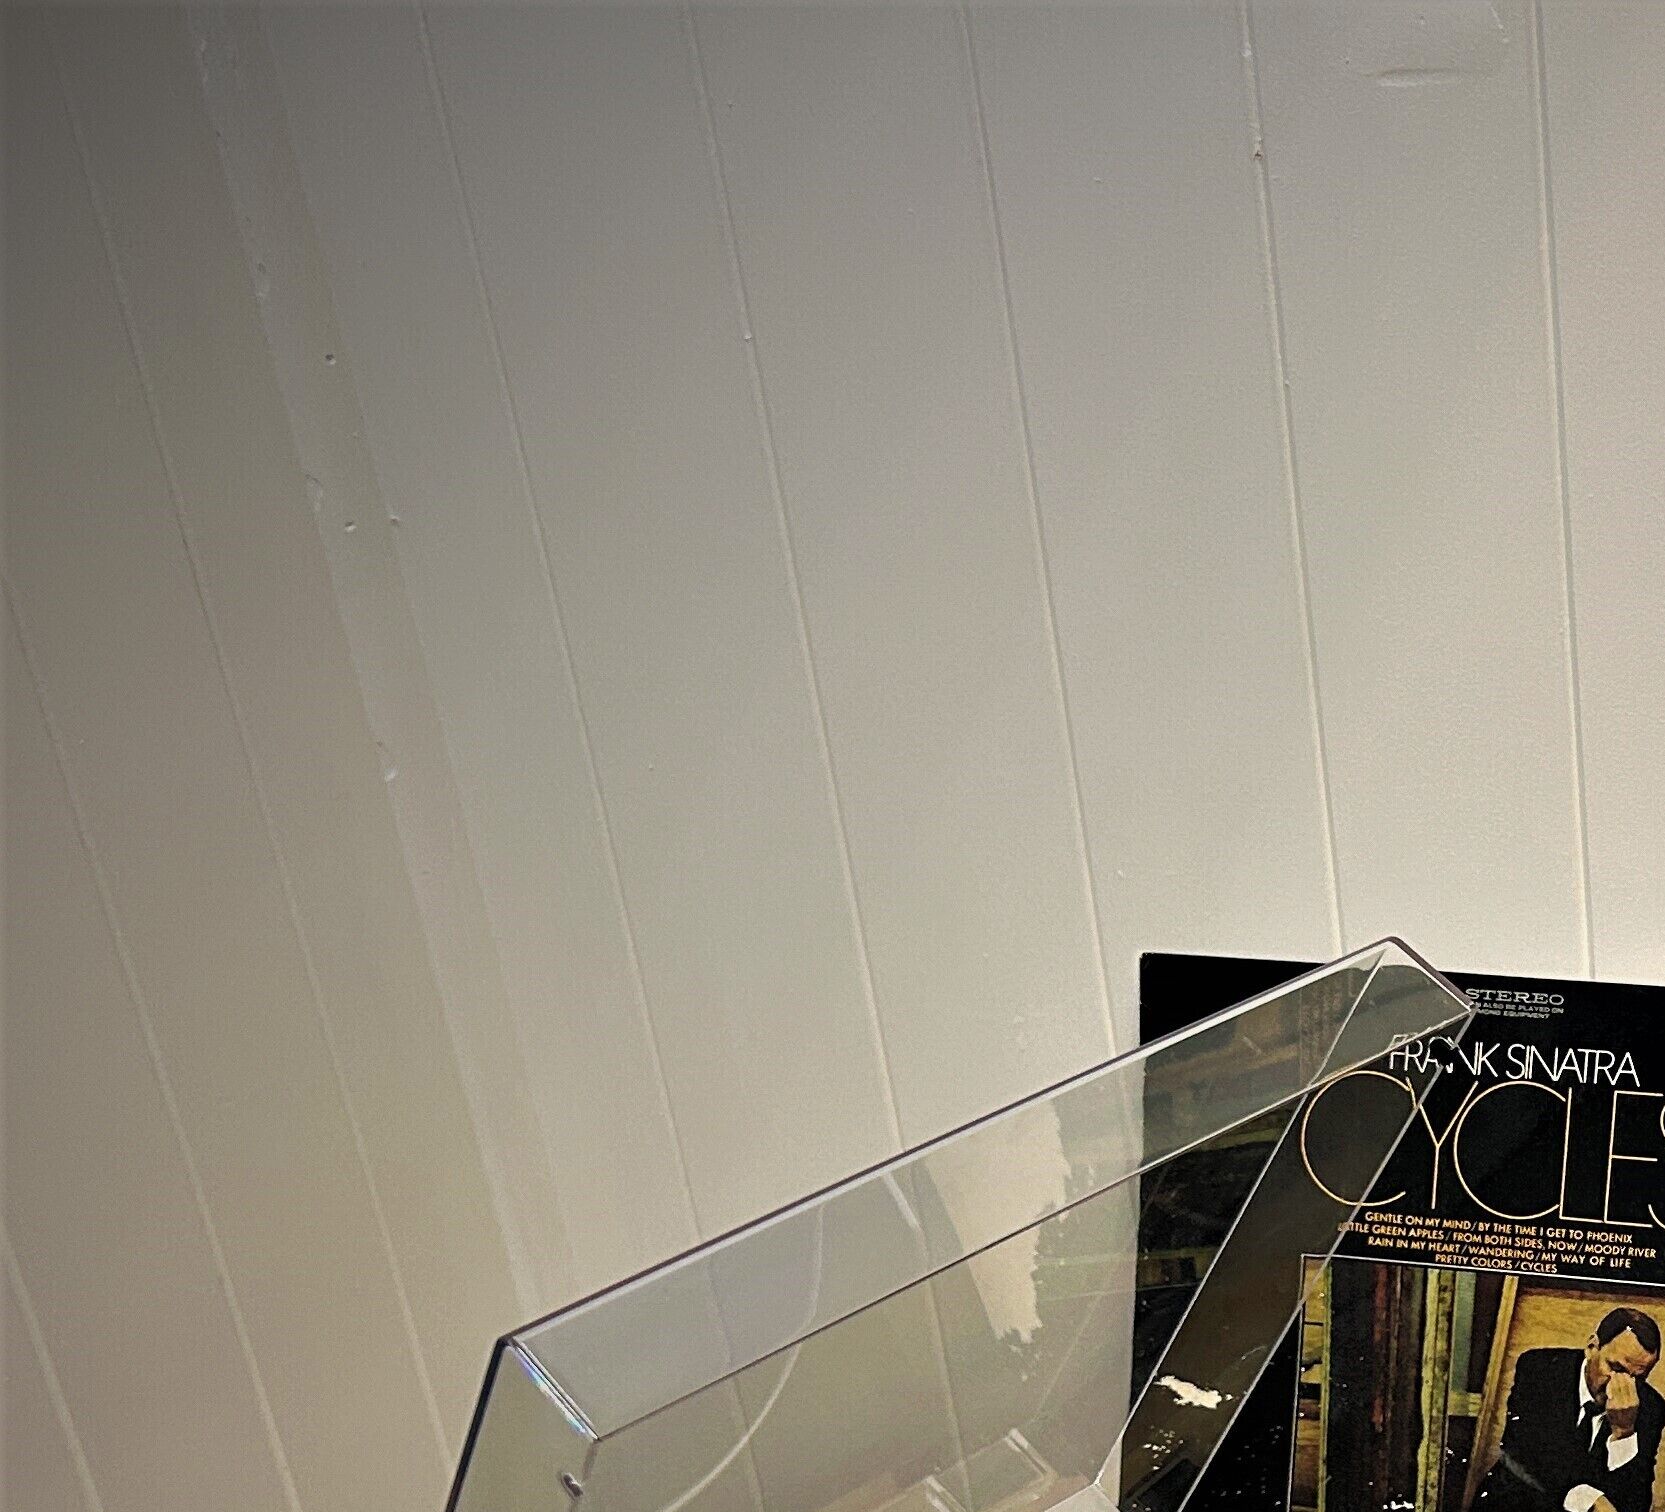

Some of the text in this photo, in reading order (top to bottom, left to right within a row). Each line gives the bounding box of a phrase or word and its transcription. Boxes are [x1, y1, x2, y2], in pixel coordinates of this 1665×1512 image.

[1465, 988, 1564, 1006] STEREO
[1389, 1035, 1641, 1087] FRANK SINATRA
[1365, 1211, 1403, 1224] GENTLE
[1405, 1215, 1423, 1226] ON
[1425, 1217, 1440, 1228] MY
[1478, 1221, 1490, 1233] BY
[1493, 1223, 1512, 1234] THE
[1514, 1224, 1537, 1236] TIME
[1539, 1227, 1543, 1236] I
[1546, 1227, 1566, 1238] GET
[1569, 1229, 1584, 1240] TO
[1586, 1232, 1633, 1244] PHOENIX
[1372, 1224, 1406, 1237] GREEN
[1408, 1228, 1444, 1240] APPLES
[1453, 1232, 1482, 1244] FROM
[1484, 1235, 1512, 1246] BOTH
[1514, 1236, 1546, 1250] SIDES,
[1547, 1240, 1577, 1252] NOW
[1584, 1243, 1626, 1256] MOODY
[1628, 1246, 1657, 1259] RIVER
[1367, 1236, 1394, 1247] RAIN
[1396, 1238, 1409, 1249] IN
[1410, 1240, 1426, 1250] MY
[1428, 1241, 1461, 1254] HEART
[1468, 1244, 1534, 1260] WANDERING
[1541, 1252, 1557, 1262] MY
[1560, 1253, 1586, 1265] WAY
[1589, 1255, 1605, 1266] OF
[1609, 1258, 1632, 1269] LIFE
[1435, 1253, 1469, 1265] PRETTY
[1470, 1256, 1513, 1269] COLORS
[1520, 1261, 1558, 1274] CYCLES
